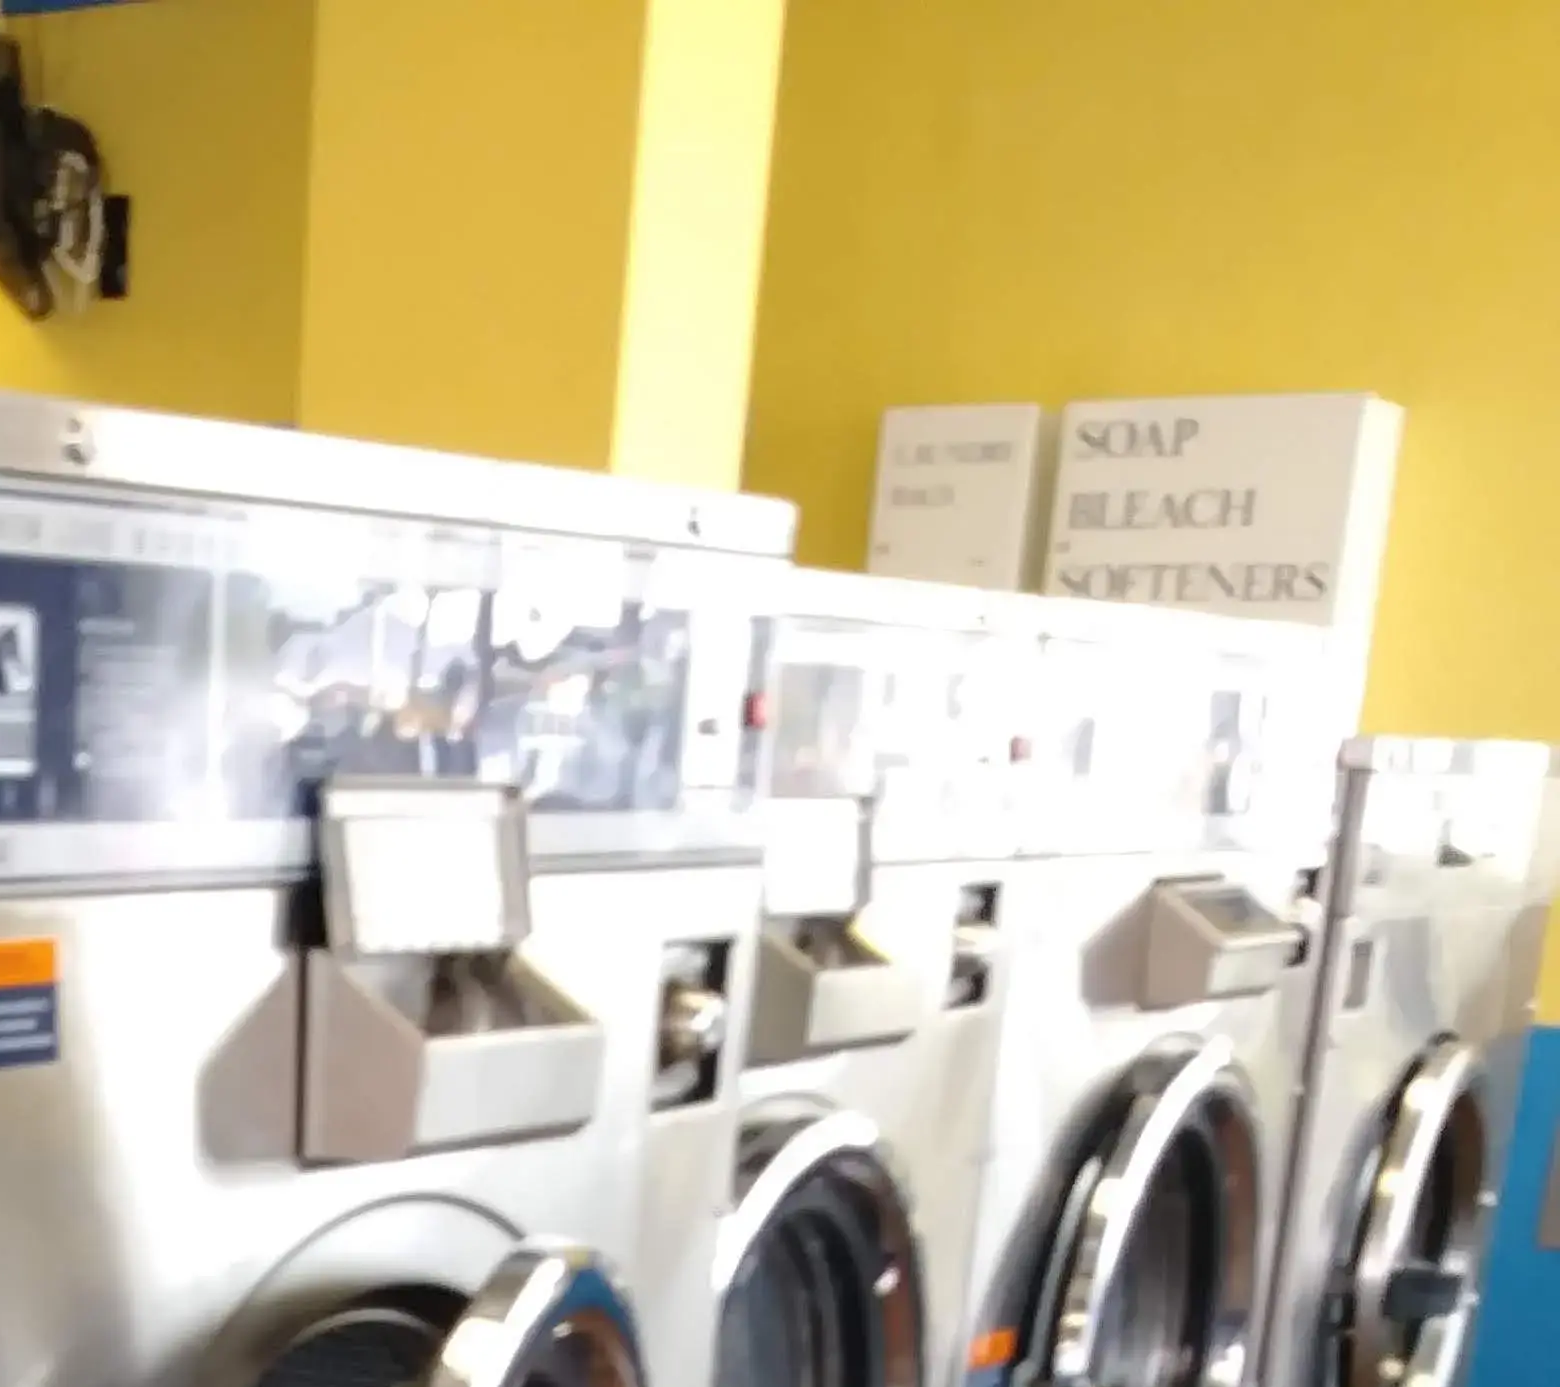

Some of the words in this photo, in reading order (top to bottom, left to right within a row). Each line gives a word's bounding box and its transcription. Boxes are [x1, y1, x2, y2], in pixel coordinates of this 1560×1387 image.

[1075, 417, 1200, 458] SOAP
[1068, 488, 1257, 530] BLEACH
[1057, 562, 1331, 602] SOFTENERS
